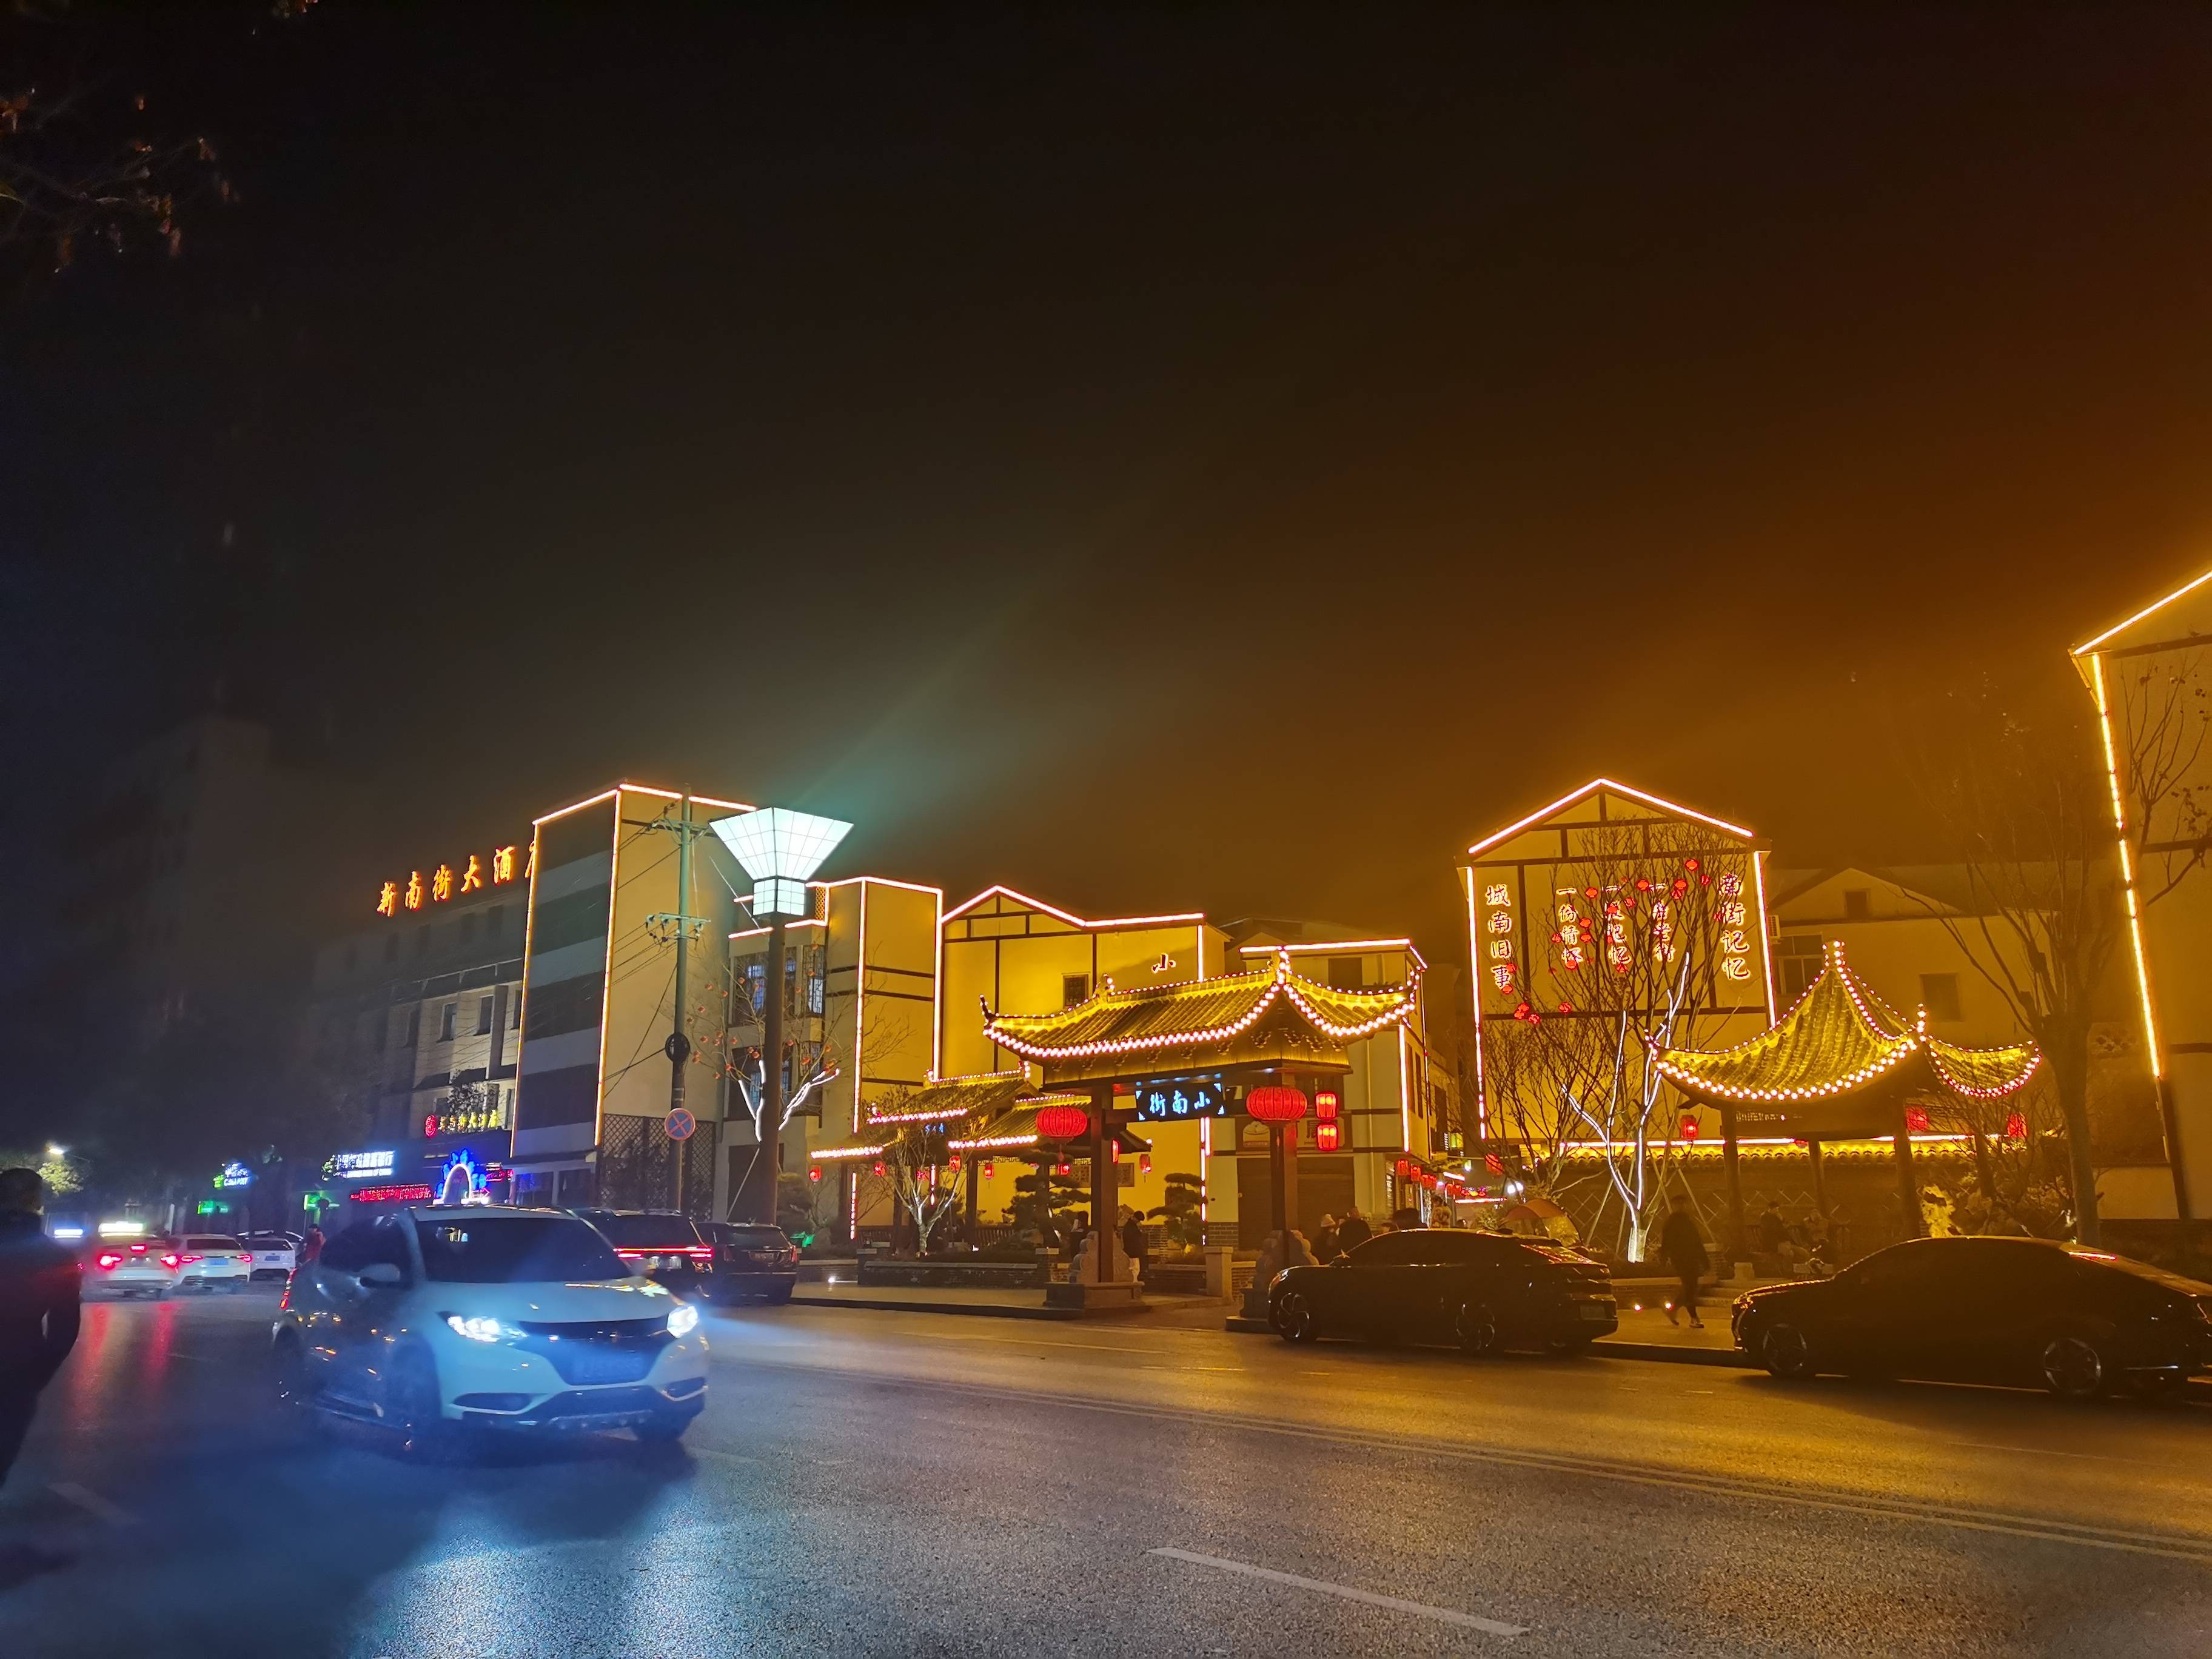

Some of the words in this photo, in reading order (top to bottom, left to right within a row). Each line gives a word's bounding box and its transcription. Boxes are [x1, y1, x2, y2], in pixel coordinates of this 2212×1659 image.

[377, 841, 535, 916] 新南街大酒
[1486, 884, 1511, 990] 城南旧事
[1556, 888, 1583, 963] 一份情怀
[1720, 874, 1751, 979] 南街记忆
